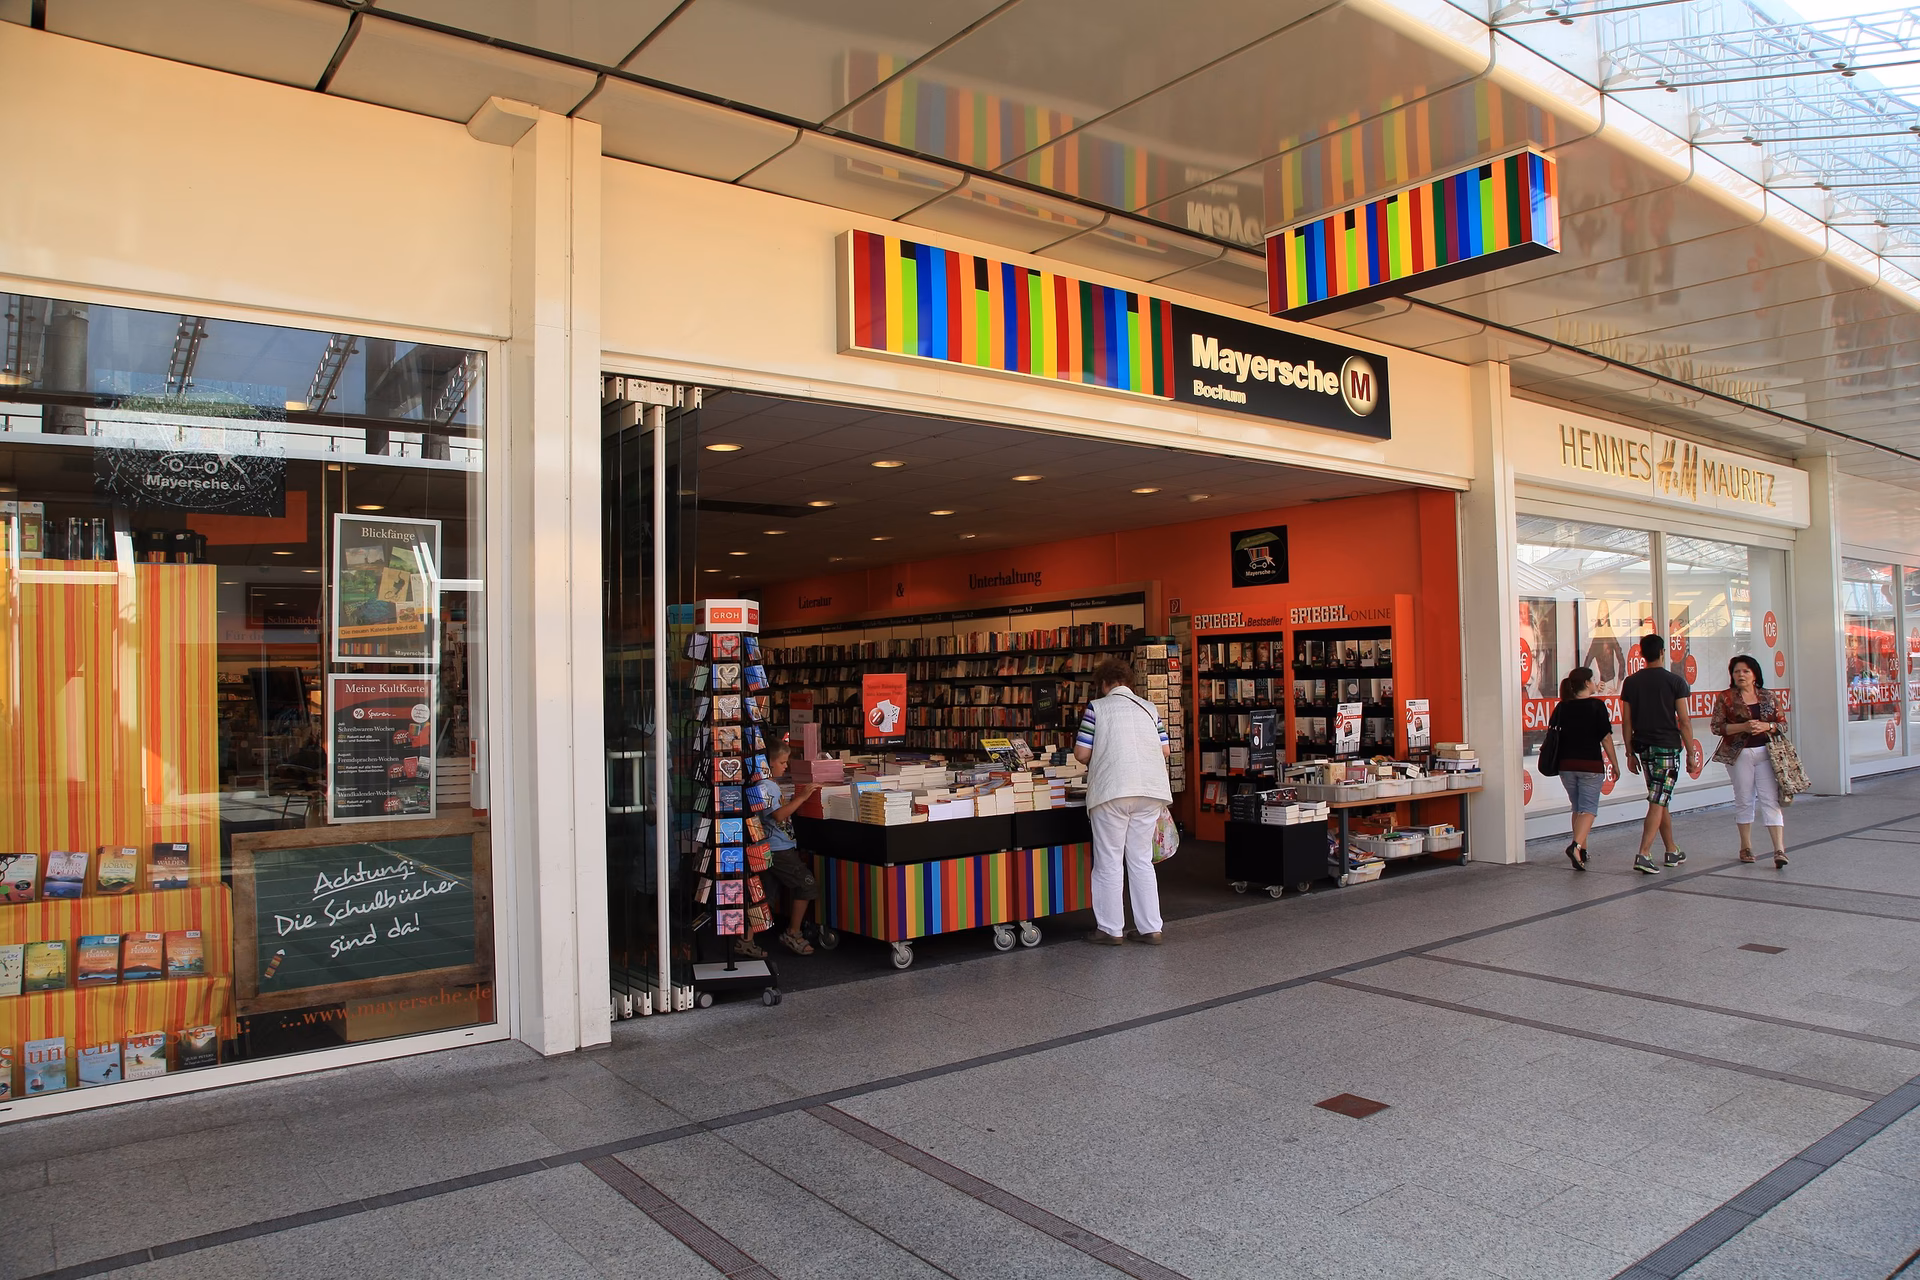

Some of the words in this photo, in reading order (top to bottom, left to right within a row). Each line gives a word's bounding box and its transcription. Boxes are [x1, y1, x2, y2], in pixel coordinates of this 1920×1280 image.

[1191, 333, 1340, 396] Mayersche
[1193, 379, 1247, 404] Bochum
[1351, 369, 1371, 402] M
[1559, 423, 1652, 483] HENNES
[1656, 438, 1698, 503] H&M
[1702, 456, 1777, 508] MAURITZ
[361, 527, 416, 542] Blickfänge
[895, 582, 904, 598] &
[969, 569, 1042, 591] Unterhaltung
[1194, 612, 1247, 630] SPIEGEL
[1247, 616, 1283, 628] Bestseller
[1290, 604, 1350, 624] SPIEGEL
[1350, 608, 1391, 622] ONLINE
[1764, 622, 1777, 638] 10€
[345, 683, 376, 693] Meine
[379, 683, 425, 693] KultKarte
[312, 860, 415, 897] Achtung:
[274, 914, 317, 936] Die
[323, 878, 458, 927] Schulbücher
[330, 923, 377, 958] sind
[387, 912, 420, 939] da!
